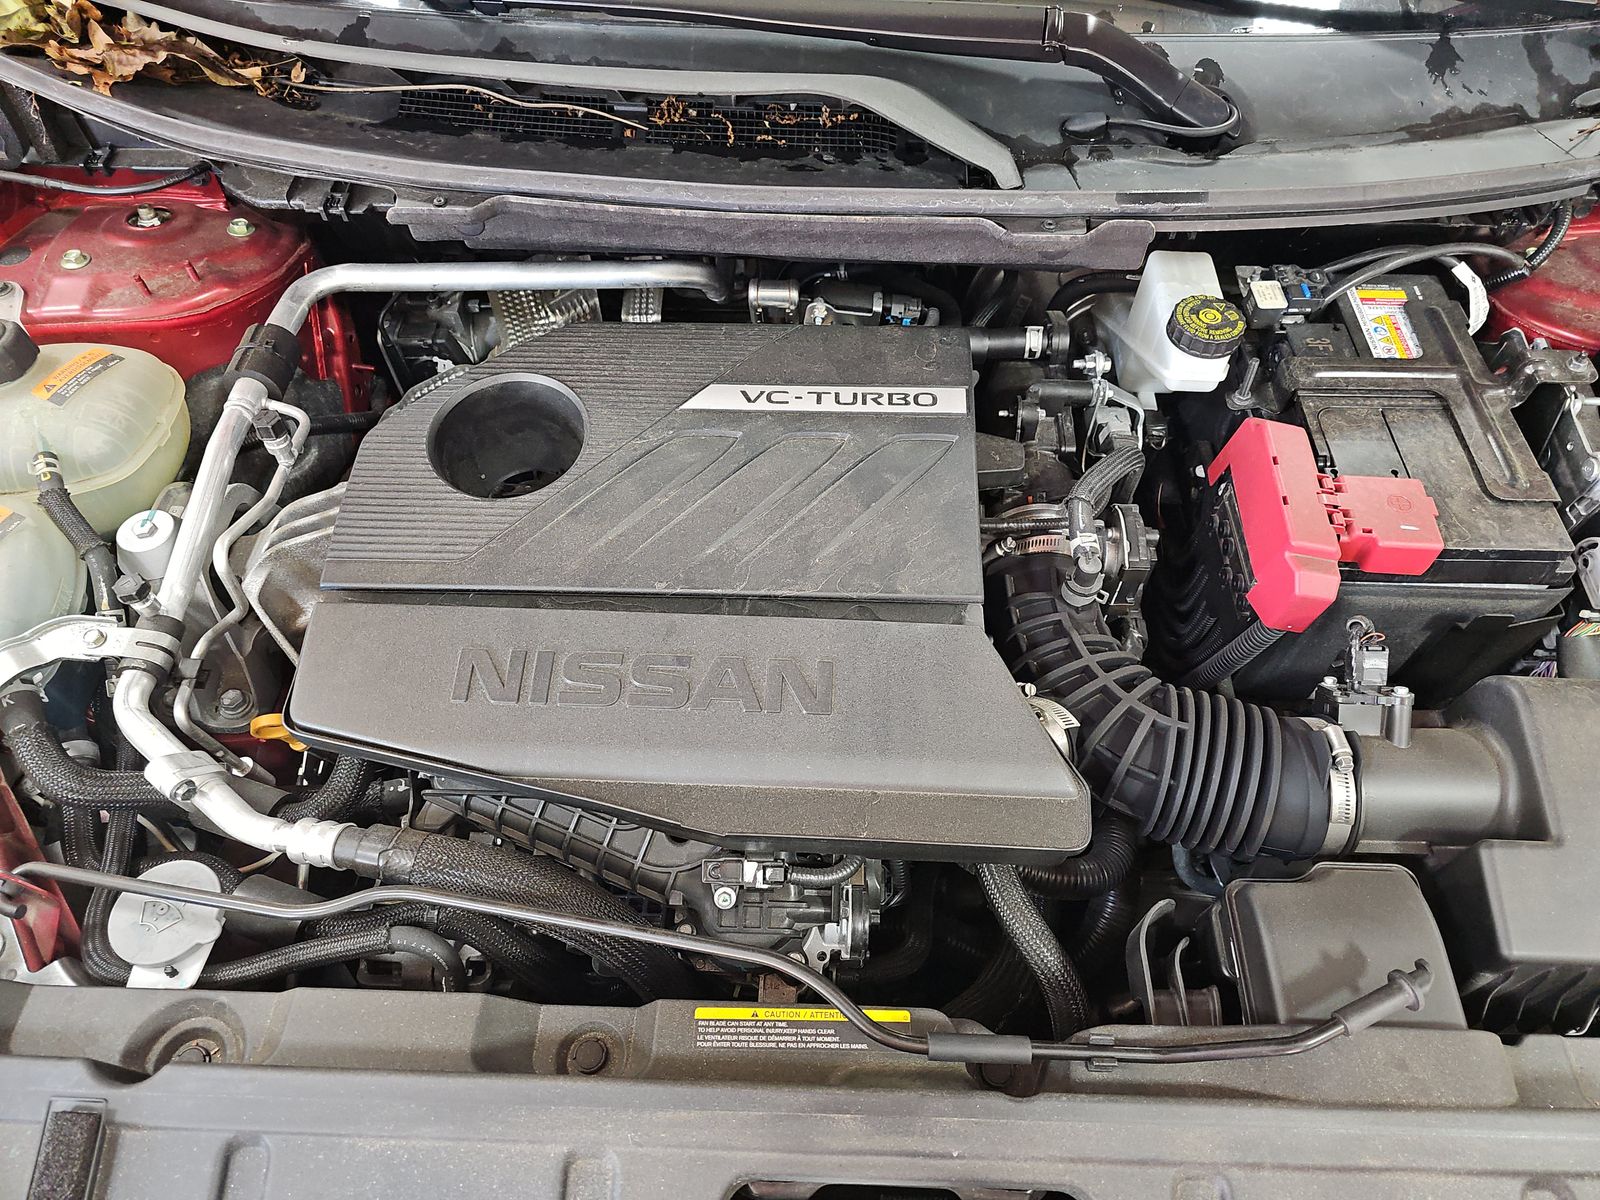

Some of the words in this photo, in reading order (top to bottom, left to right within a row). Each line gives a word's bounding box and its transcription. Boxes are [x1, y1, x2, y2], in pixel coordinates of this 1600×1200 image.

[739, 390, 938, 407] VC-TURBO
[450, 648, 833, 715] NISSAN
[764, 1010, 800, 1018] CAUTION
[810, 1011, 845, 1019] ATTENTI
